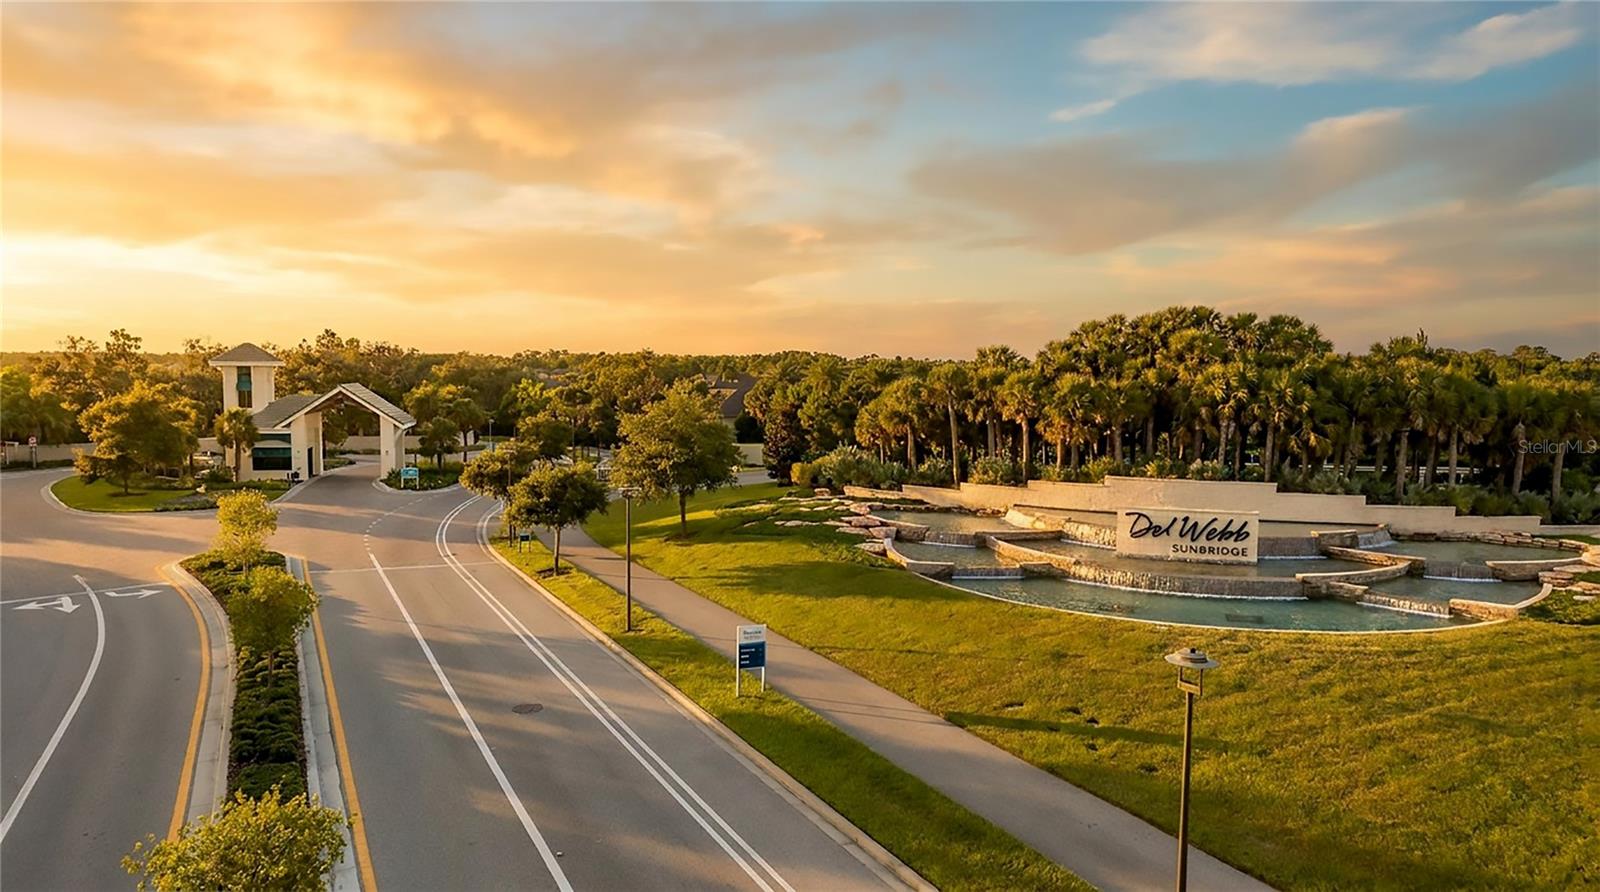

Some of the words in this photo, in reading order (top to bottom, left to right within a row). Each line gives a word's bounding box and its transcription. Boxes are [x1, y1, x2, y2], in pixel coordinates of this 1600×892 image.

[1125, 511, 1178, 539] Del
[1178, 515, 1250, 543] Webb
[1171, 543, 1249, 557] SUNBRIDGE
